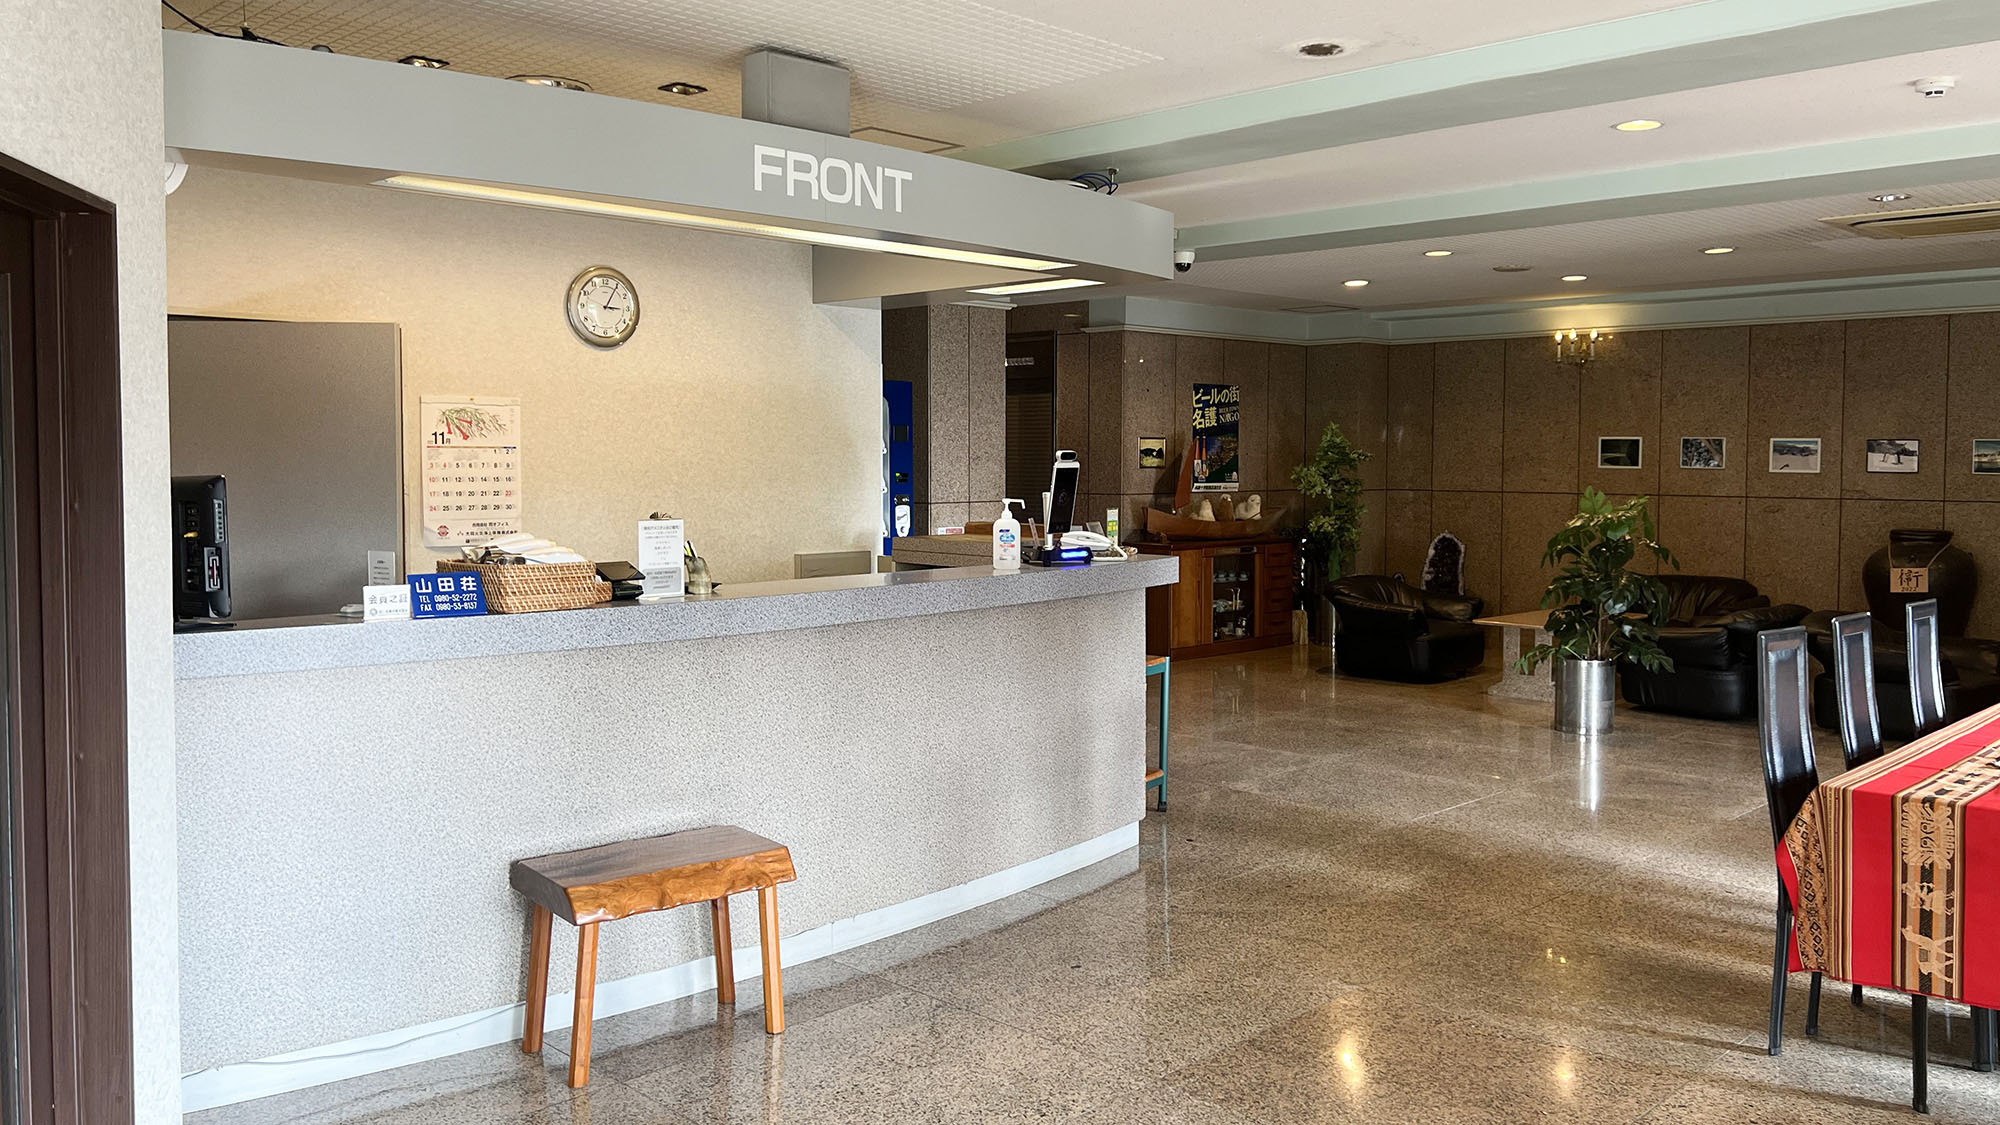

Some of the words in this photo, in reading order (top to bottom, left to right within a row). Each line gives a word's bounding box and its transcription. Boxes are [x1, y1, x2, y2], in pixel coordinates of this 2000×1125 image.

[754, 144, 913, 213] FRONT
[1192, 385, 1240, 408] ビールの街
[1192, 406, 1218, 430] 名護
[1219, 411, 1240, 424] NAGO
[415, 576, 478, 593] 山田荘
[419, 595, 431, 603] TEL
[434, 593, 478, 603] 0980-52-2272
[420, 603, 432, 611] FAX
[435, 602, 478, 611] 0980-53-8137
